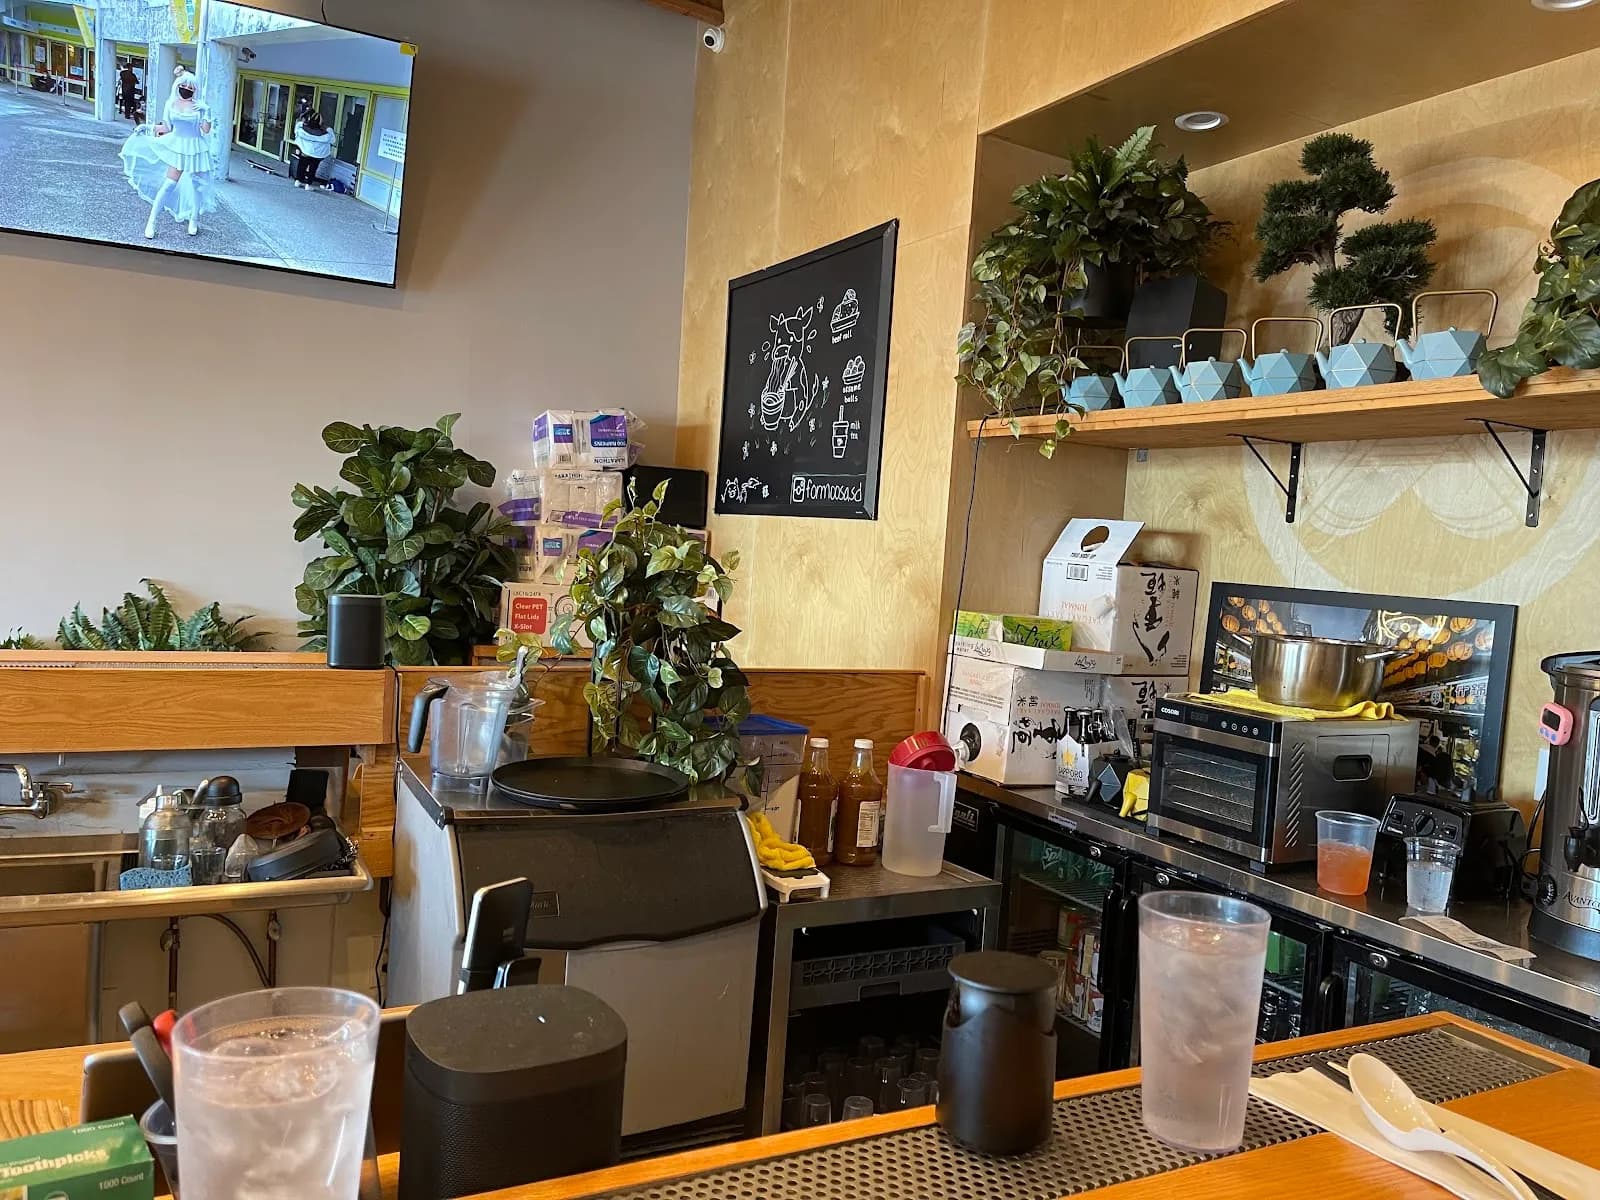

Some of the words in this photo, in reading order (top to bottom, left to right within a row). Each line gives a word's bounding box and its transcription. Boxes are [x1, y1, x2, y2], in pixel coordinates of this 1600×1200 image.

[844, 393, 859, 403] balls
[515, 602, 531, 610] Clear
[1058, 766, 1083, 779] SAPPORO
[98, 1121, 125, 1130] Count
[0, 1148, 110, 1178] Toothpicks
[99, 1177, 119, 1190] 1000
[121, 1172, 144, 1184] Count
